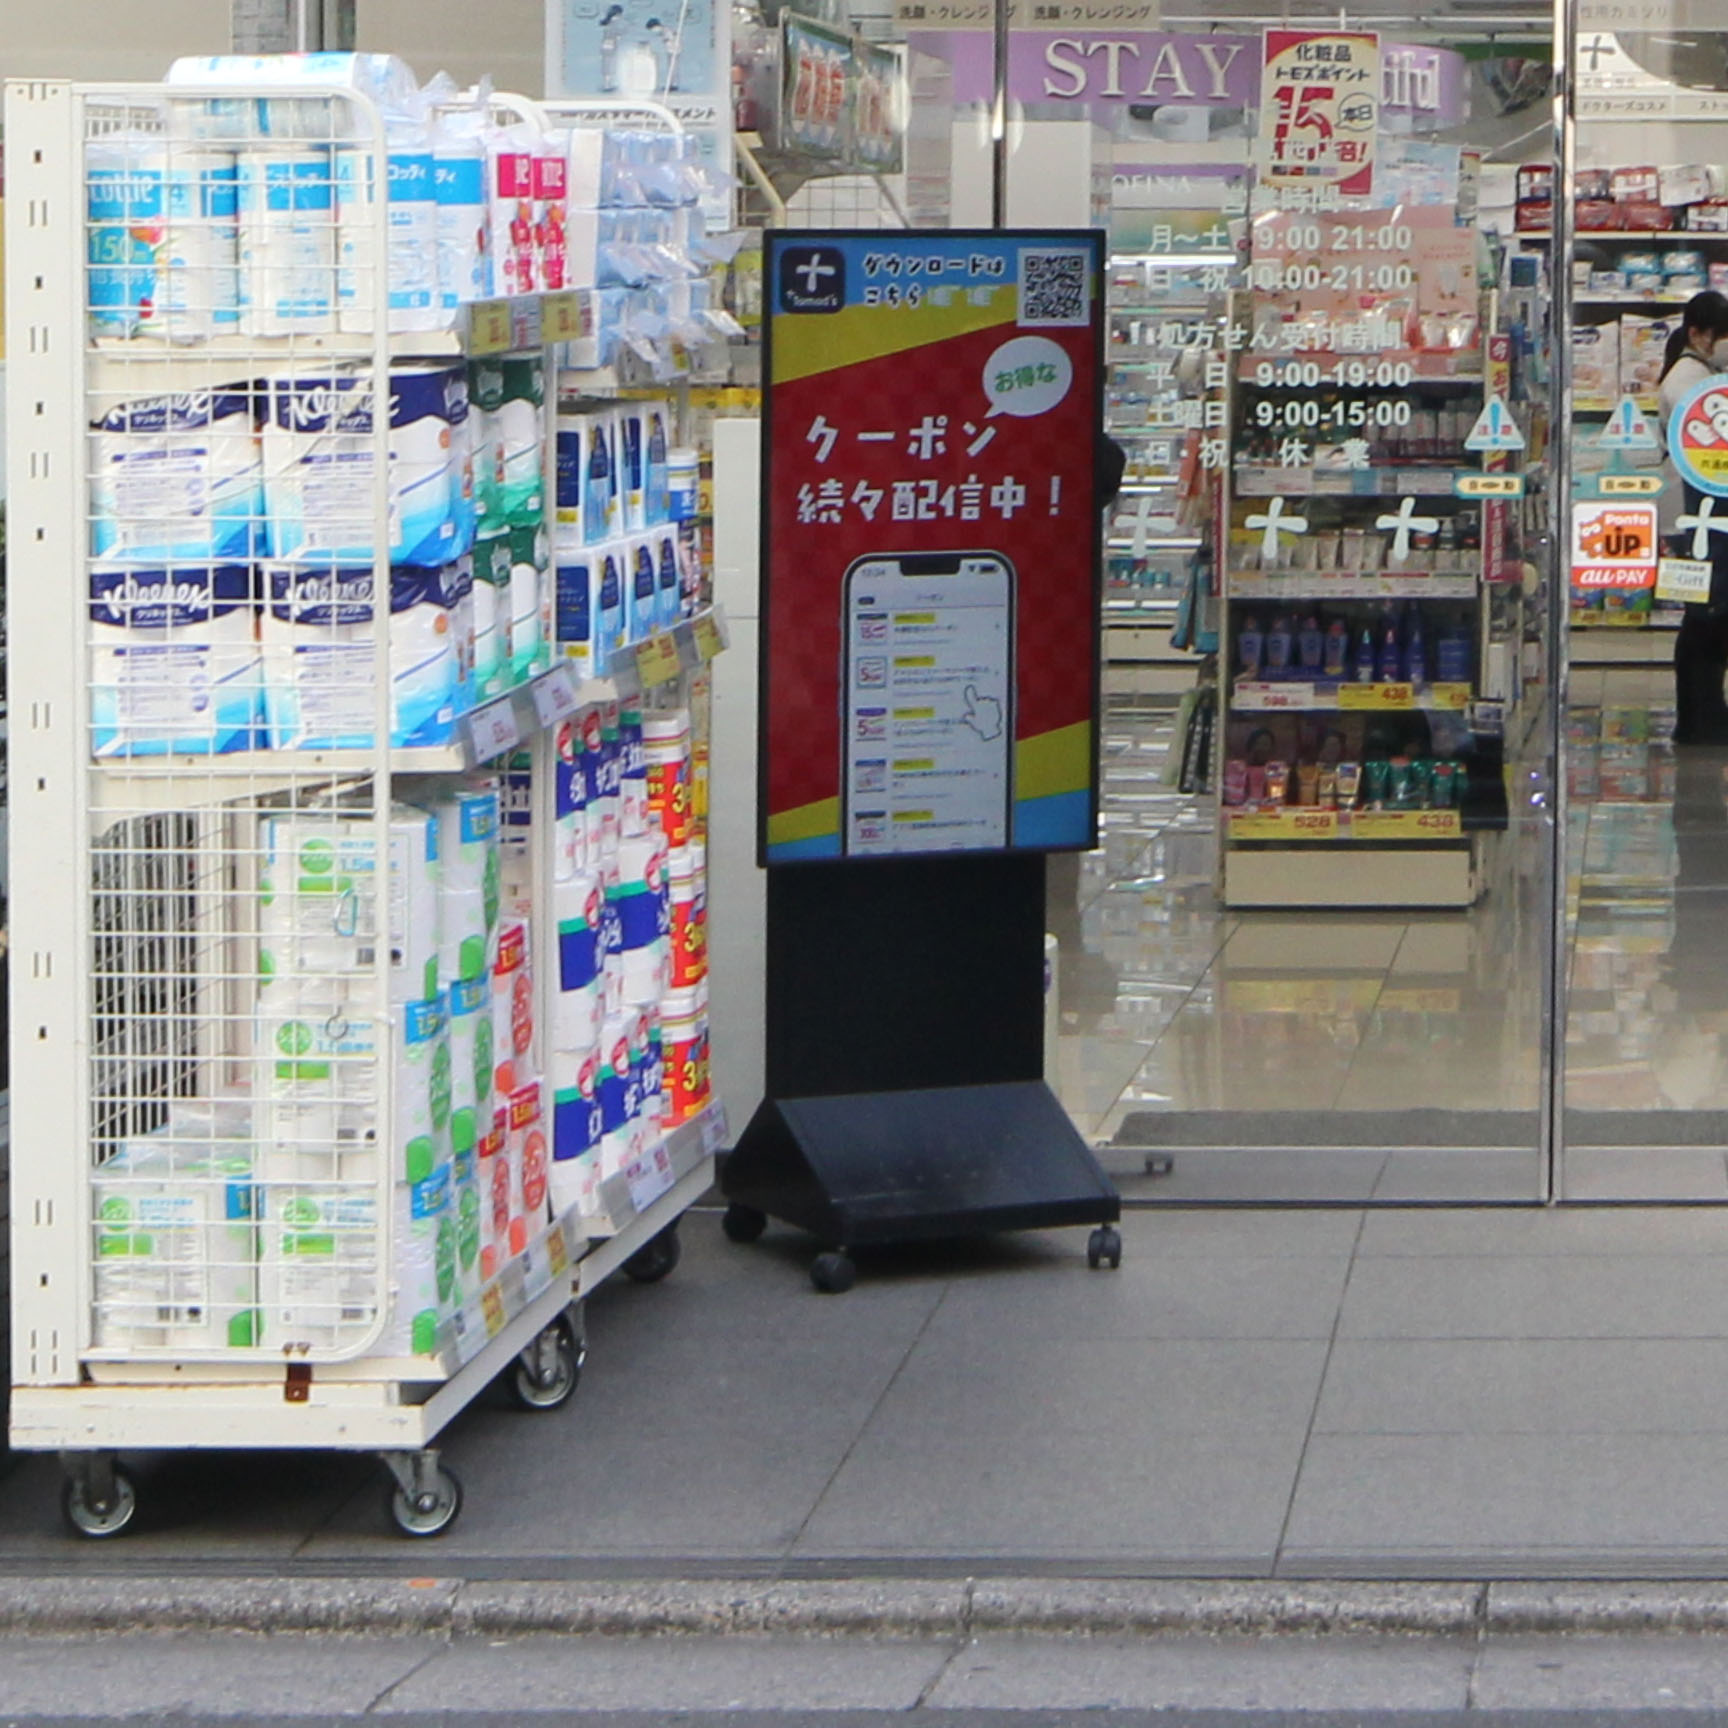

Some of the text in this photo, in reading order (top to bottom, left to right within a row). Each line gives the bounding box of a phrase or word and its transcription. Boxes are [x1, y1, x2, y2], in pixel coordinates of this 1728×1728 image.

[1296, 43, 1352, 63] 化粧品
[994, 362, 1058, 393] お得な
[1256, 362, 1412, 388] 9:00-19:00
[1256, 401, 1412, 427] 9:00-15:00
[805, 415, 997, 464] クーポン
[1604, 512, 1650, 526] Ponta
[1579, 568, 1648, 584] au PAY
